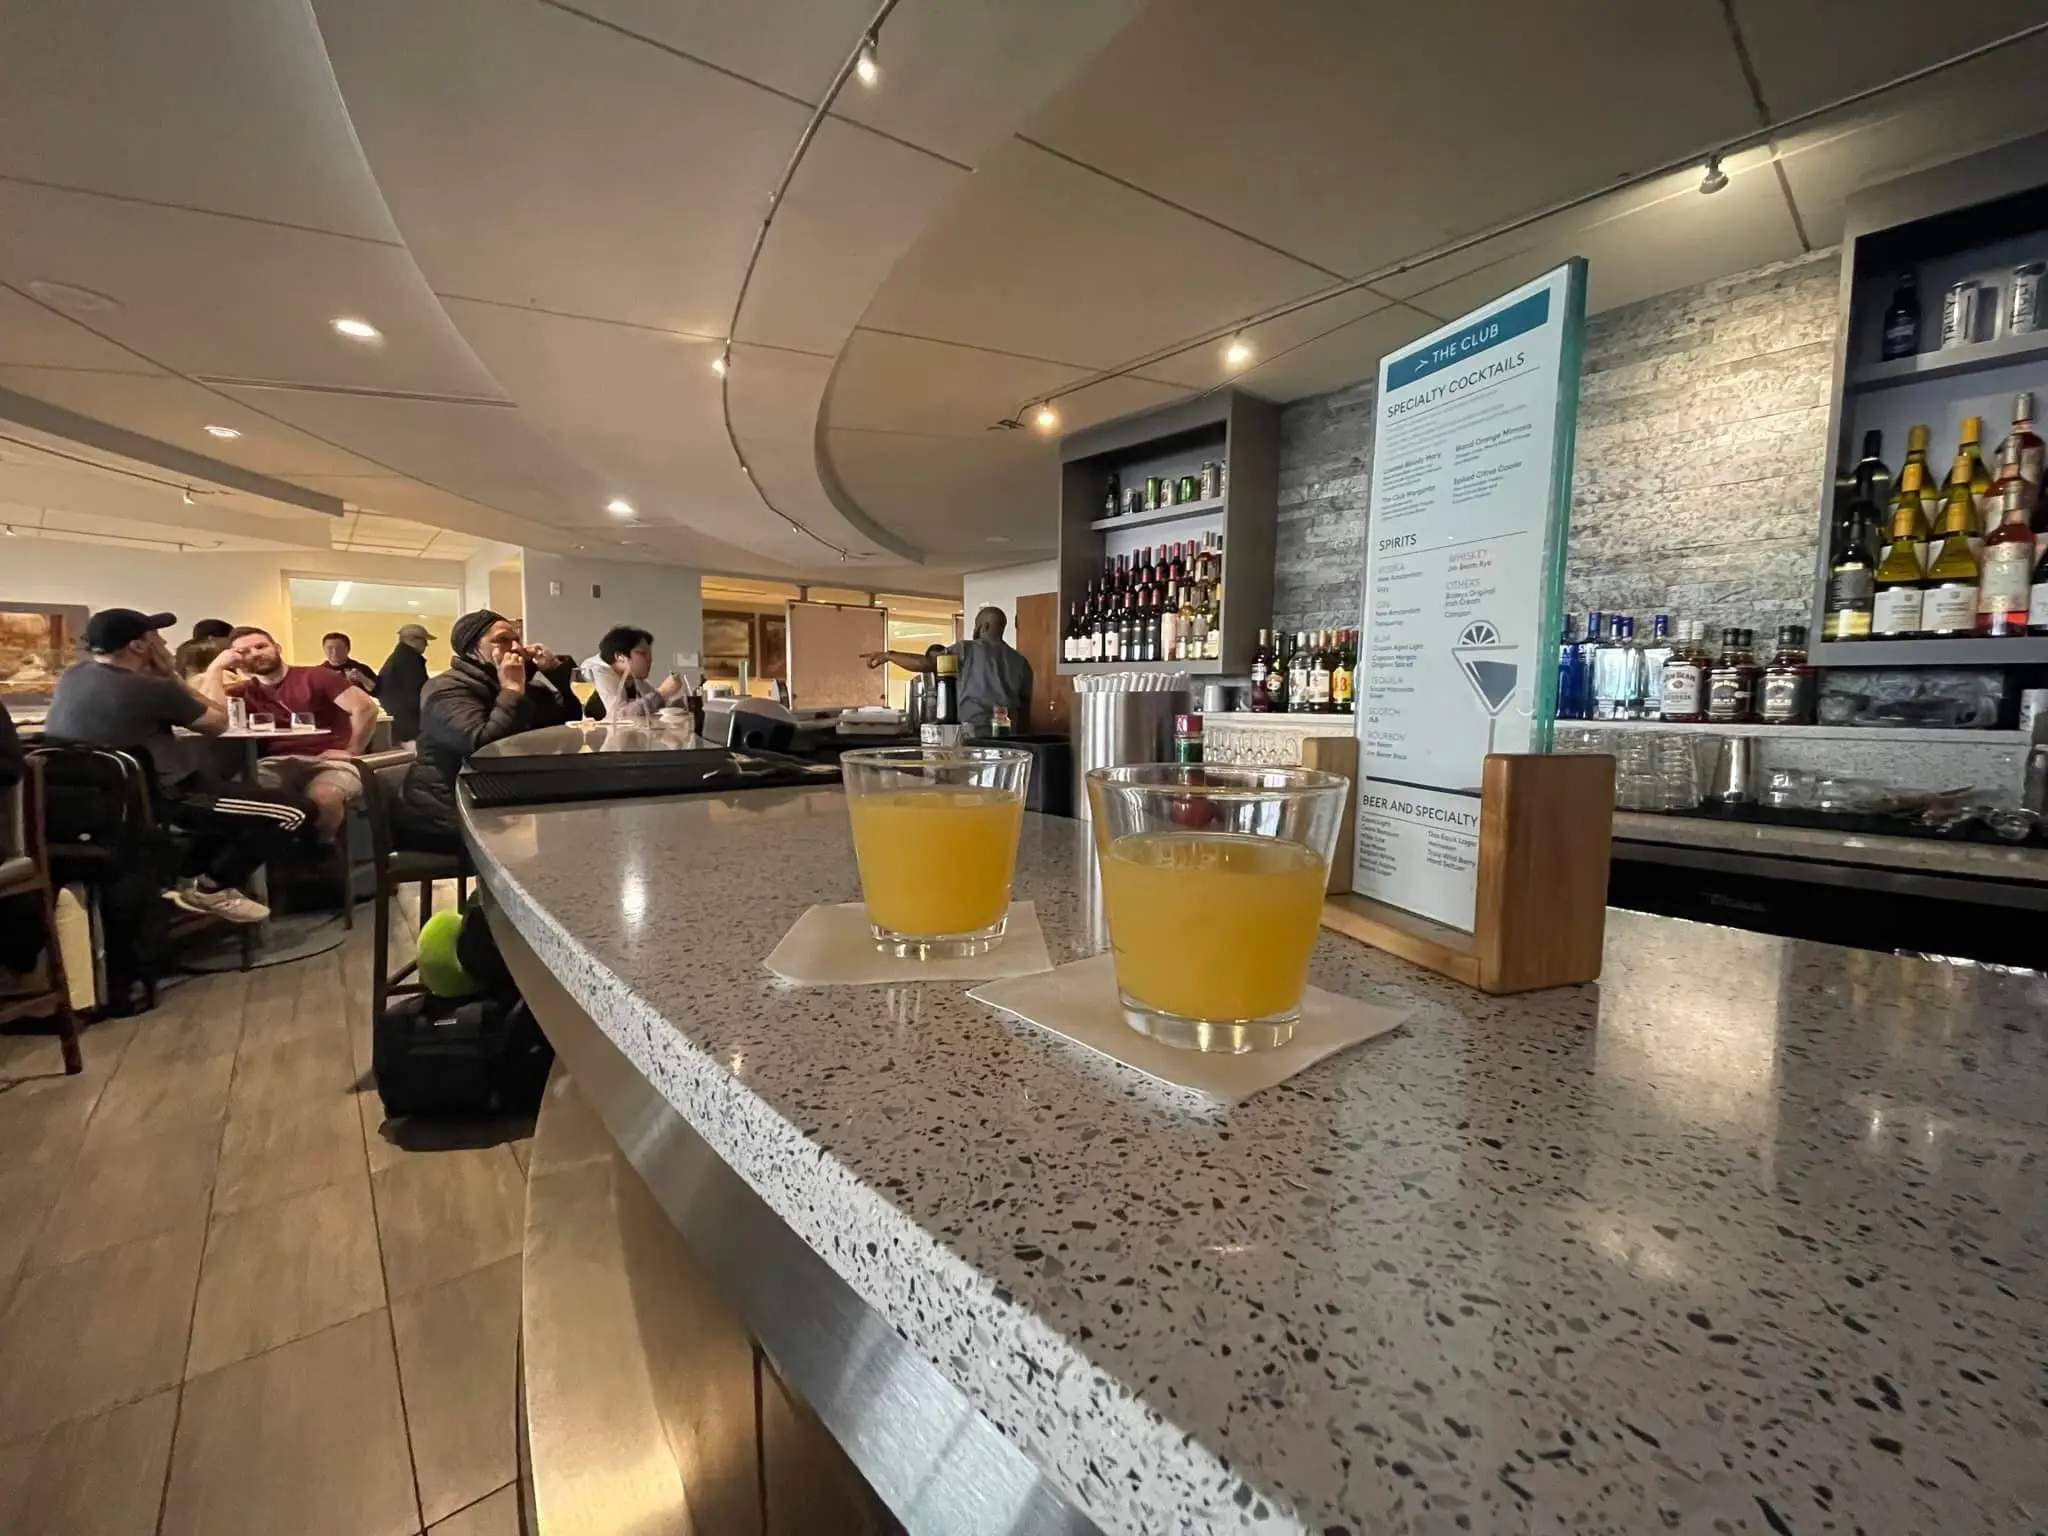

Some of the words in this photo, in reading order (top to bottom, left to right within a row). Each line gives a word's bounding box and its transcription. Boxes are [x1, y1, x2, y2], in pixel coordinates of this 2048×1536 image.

[1432, 342, 1457, 364] THE
[1460, 323, 1499, 351] CLUB
[1387, 385, 1447, 419] SPECIALTY
[1448, 351, 1526, 394] COCKTAILS
[1379, 533, 1417, 552] SPIRITS
[1363, 794, 1388, 809] BEER
[1389, 800, 1413, 814] AND
[1415, 804, 1478, 828] SPECIALTY
